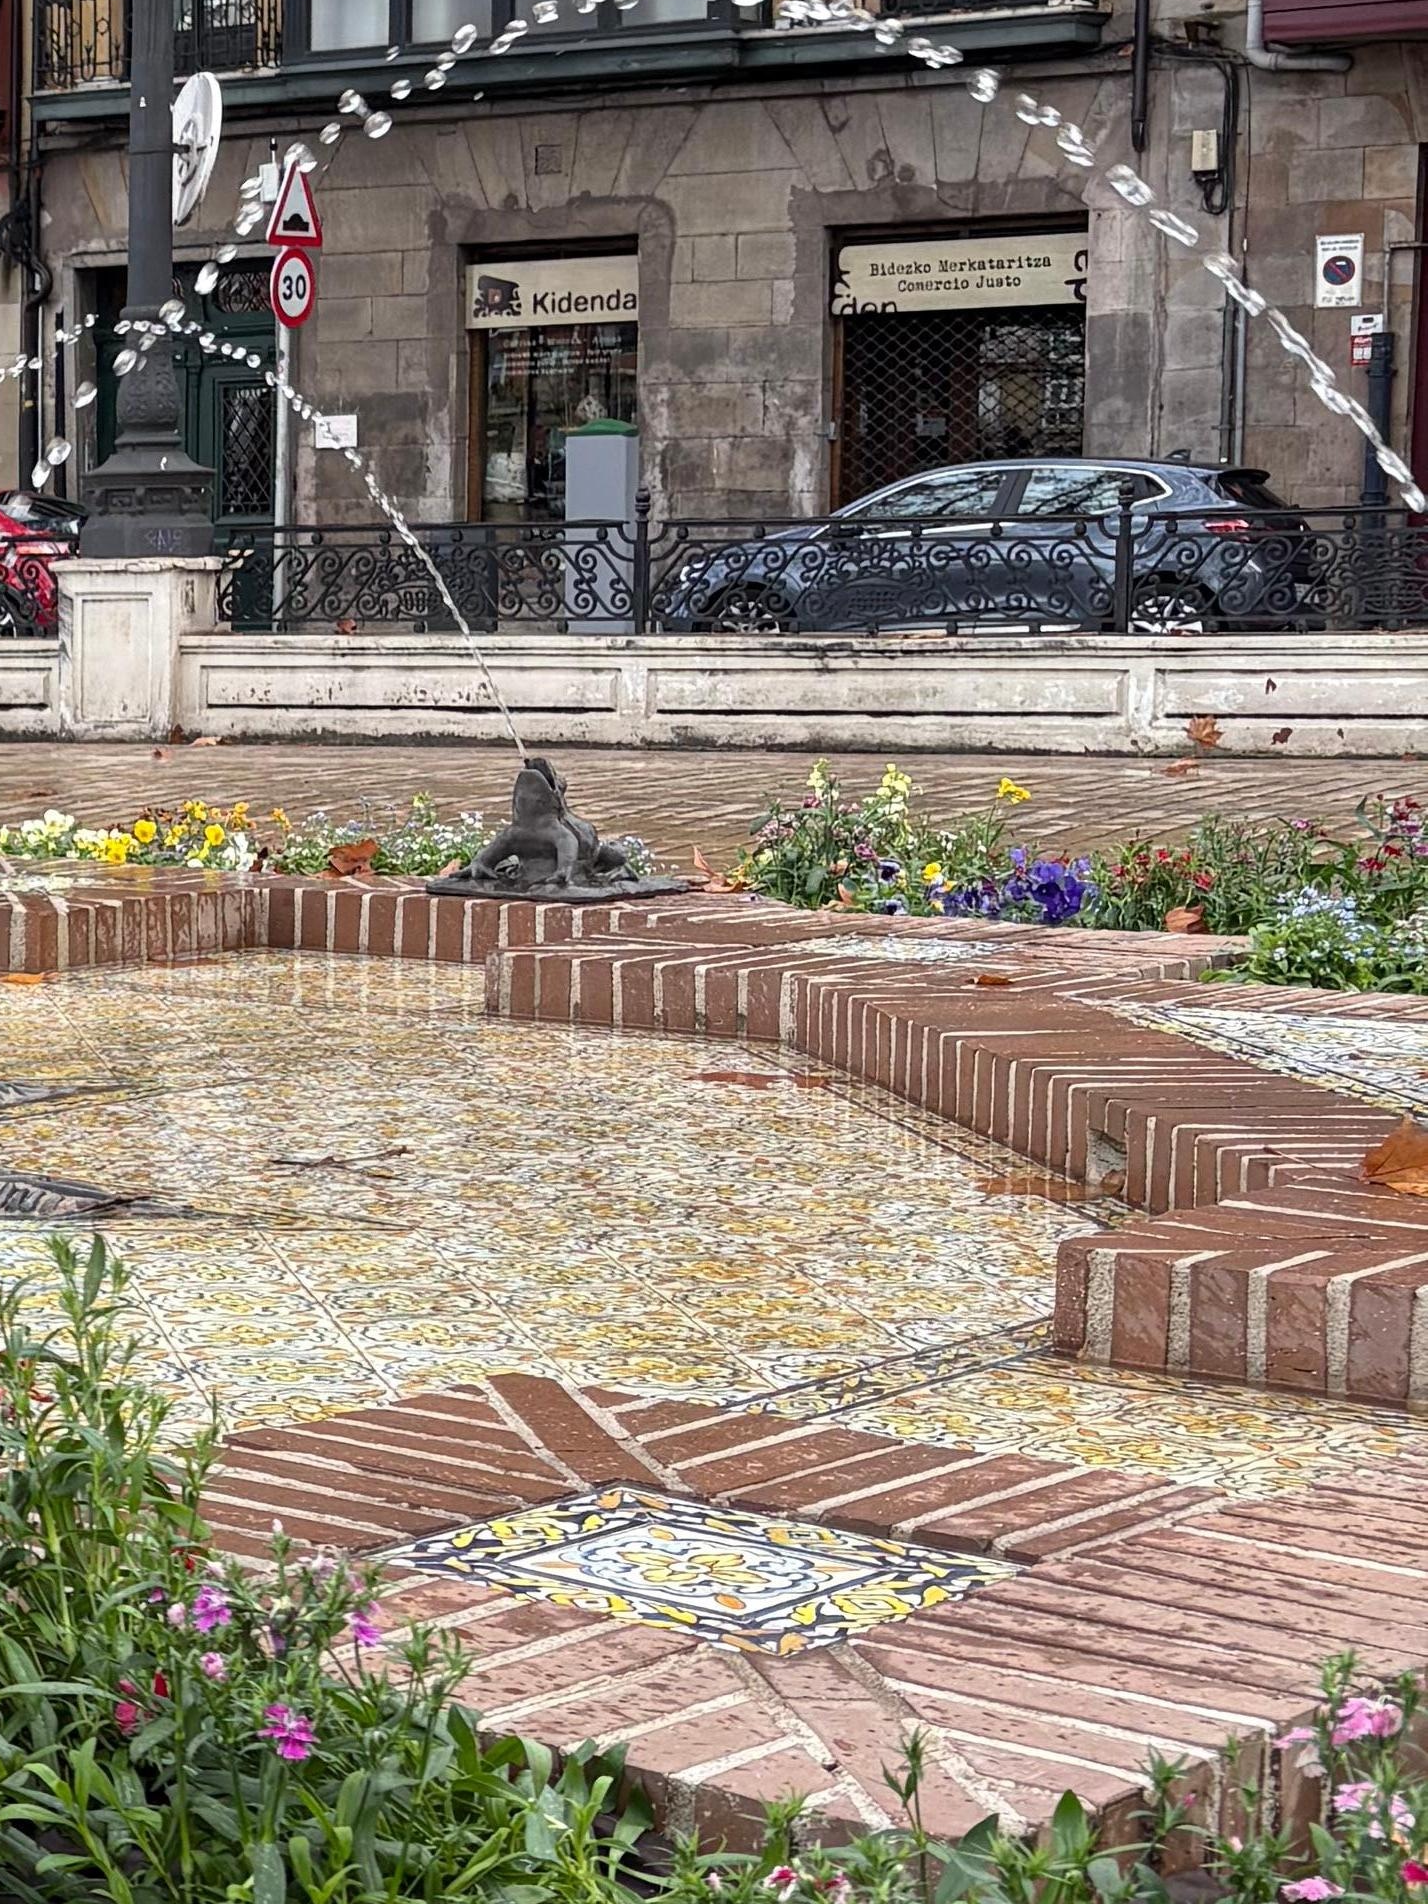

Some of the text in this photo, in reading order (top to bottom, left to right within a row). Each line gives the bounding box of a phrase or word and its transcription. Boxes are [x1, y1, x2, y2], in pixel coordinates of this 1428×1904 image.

[869, 255, 1052, 276] Bidezko Merkataritza
[282, 274, 306, 301] 30
[897, 274, 1022, 293] Comercio Justo
[532, 288, 637, 315] Kidenda
